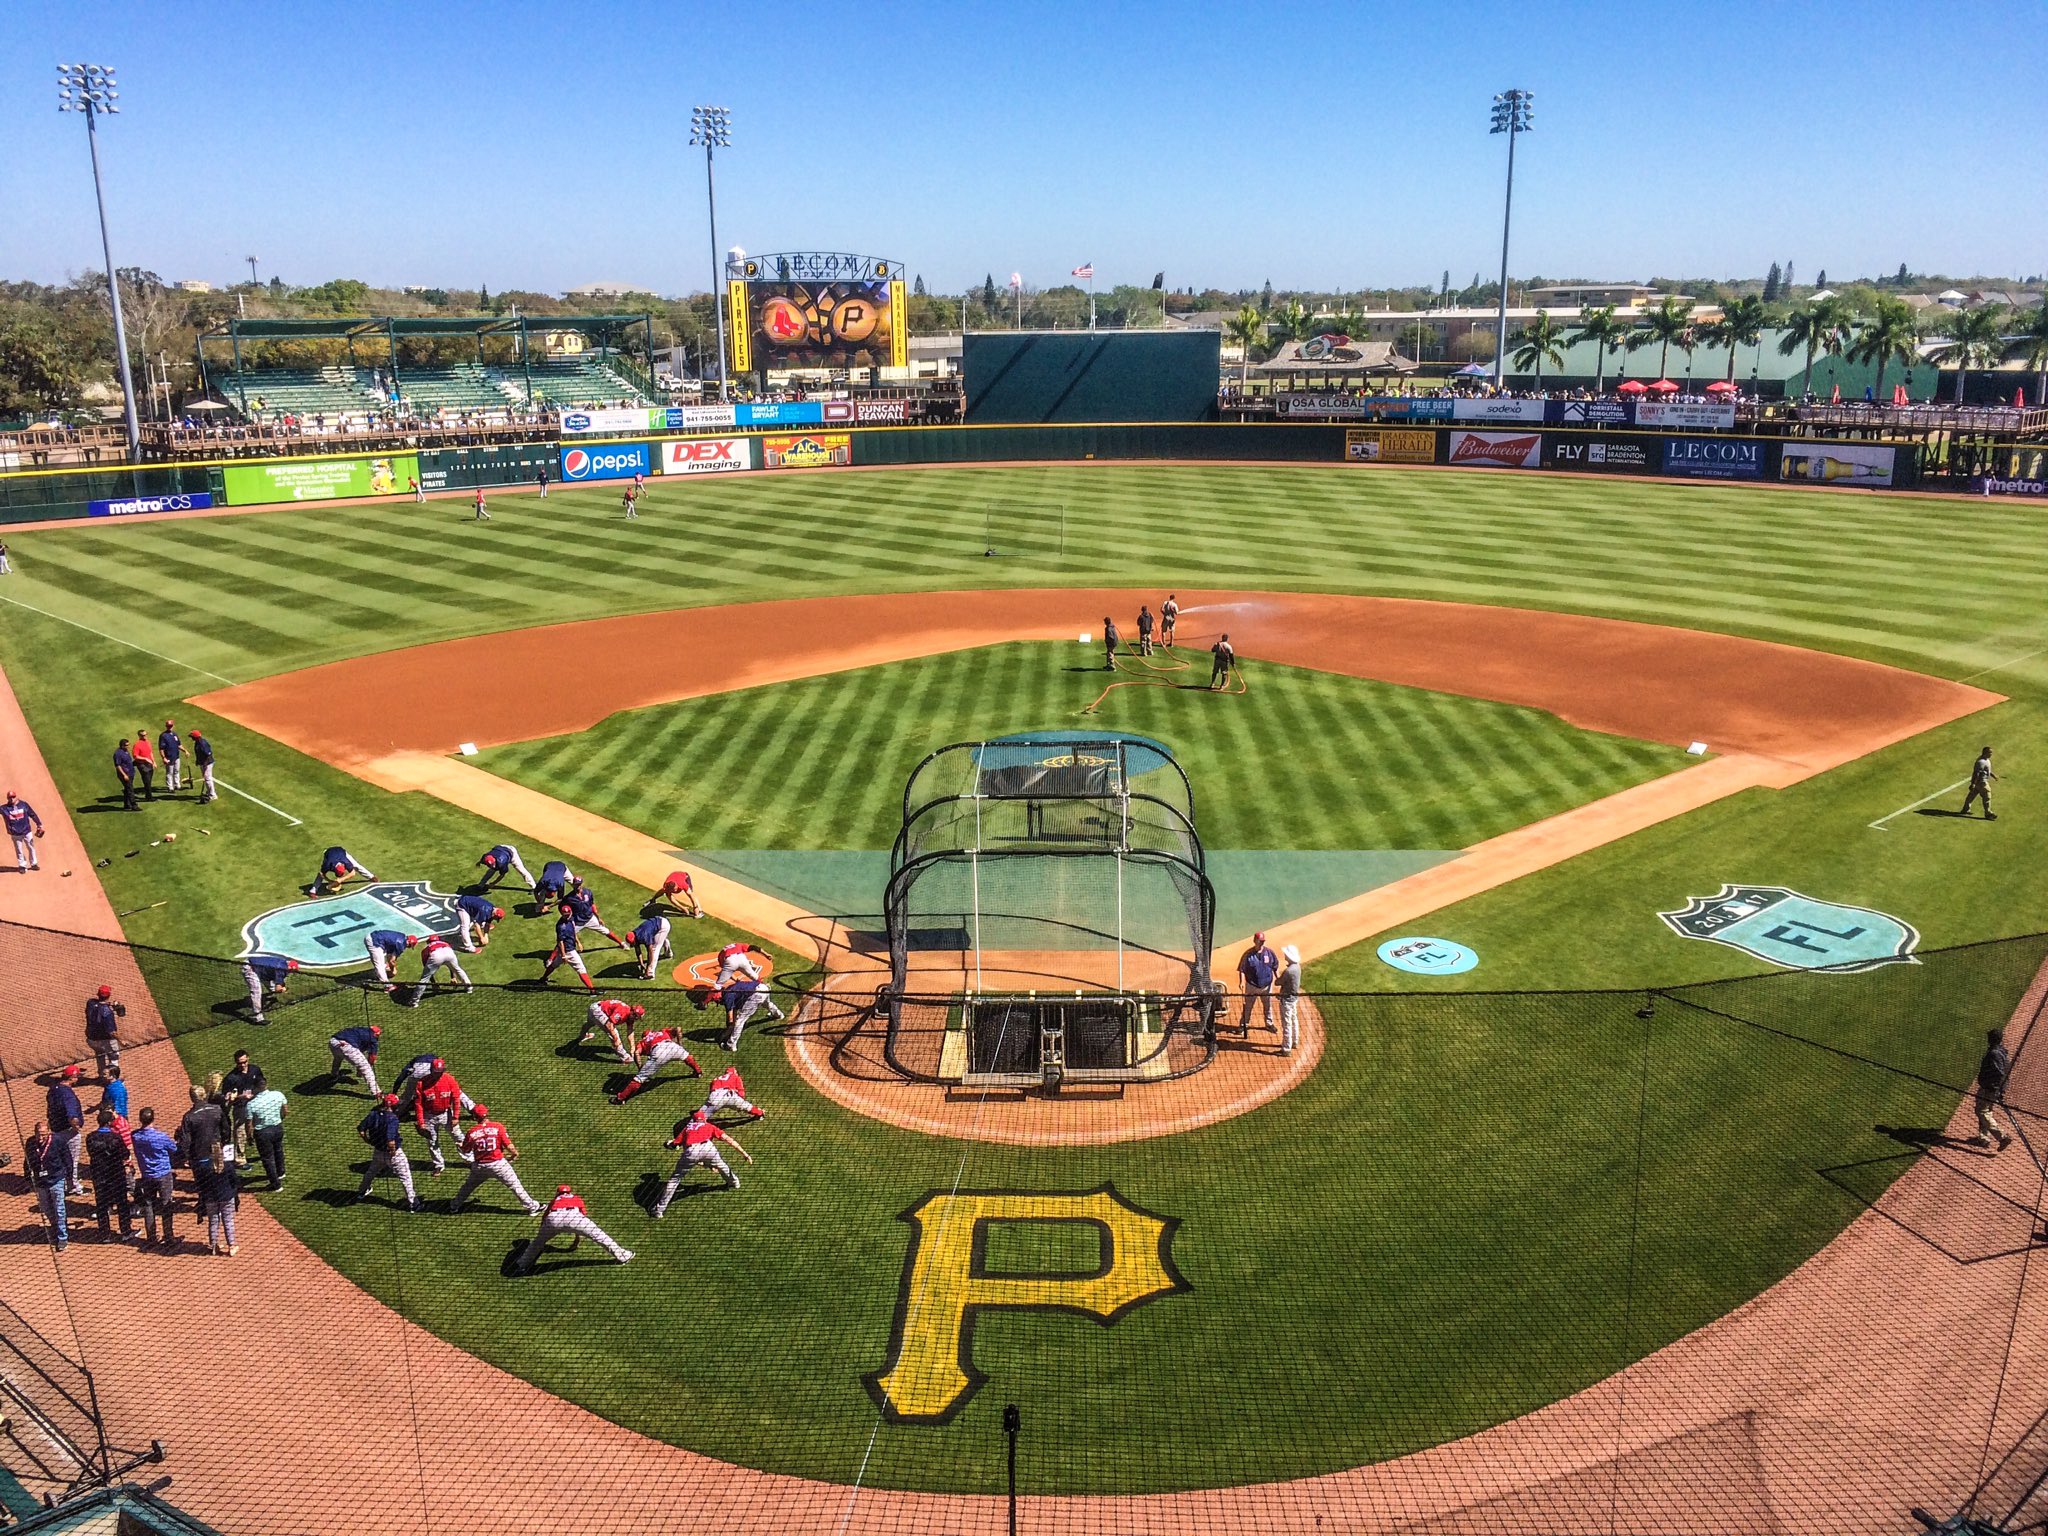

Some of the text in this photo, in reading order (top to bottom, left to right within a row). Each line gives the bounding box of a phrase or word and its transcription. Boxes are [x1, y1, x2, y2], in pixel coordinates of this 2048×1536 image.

[747, 264, 755, 273] P
[776, 255, 859, 272] LECOM
[878, 265, 886, 274] B
[841, 305, 864, 333] P
[895, 285, 903, 363] MARAUDERS
[735, 285, 745, 366] PIRATES
[1292, 398, 1365, 408] OSA GLOBAL
[1412, 401, 1453, 409] FREE BEER
[751, 405, 779, 413] FAWLEY
[858, 405, 904, 413] DUNCAN
[1486, 404, 1522, 414] sodexo
[1639, 406, 1666, 415] SONNY'S
[751, 411, 779, 419] BRYANT
[858, 411, 904, 420] SEAWALL
[1382, 432, 1433, 440] BRADENTON
[797, 441, 816, 453] A/C
[1382, 439, 1433, 451] HERALD
[1458, 440, 1531, 457] Budweiser
[1607, 444, 1639, 452] SARASOTA
[672, 442, 736, 462] DEX
[784, 452, 830, 461] WAREHOUSE
[1556, 444, 1584, 459] FLY
[1591, 452, 1604, 461] srq
[1607, 451, 1646, 459] BRADENTON
[1670, 442, 1758, 461] LECOM
[593, 450, 641, 473] pepsi
[688, 460, 742, 471] imaging
[317, 463, 357, 473] HOSPITAL
[421, 471, 448, 479] VISITORS
[422, 480, 446, 488] PIRATES
[109, 496, 192, 514] metroPCS
[383, 890, 406, 904] 20
[1744, 894, 1769, 906] 17
[426, 912, 452, 926] 17
[1694, 916, 1724, 930] 20
[290, 909, 376, 949] FL
[1761, 920, 1868, 954] FL
[1414, 952, 1448, 963] FL
[860, 1180, 1195, 1426] P
